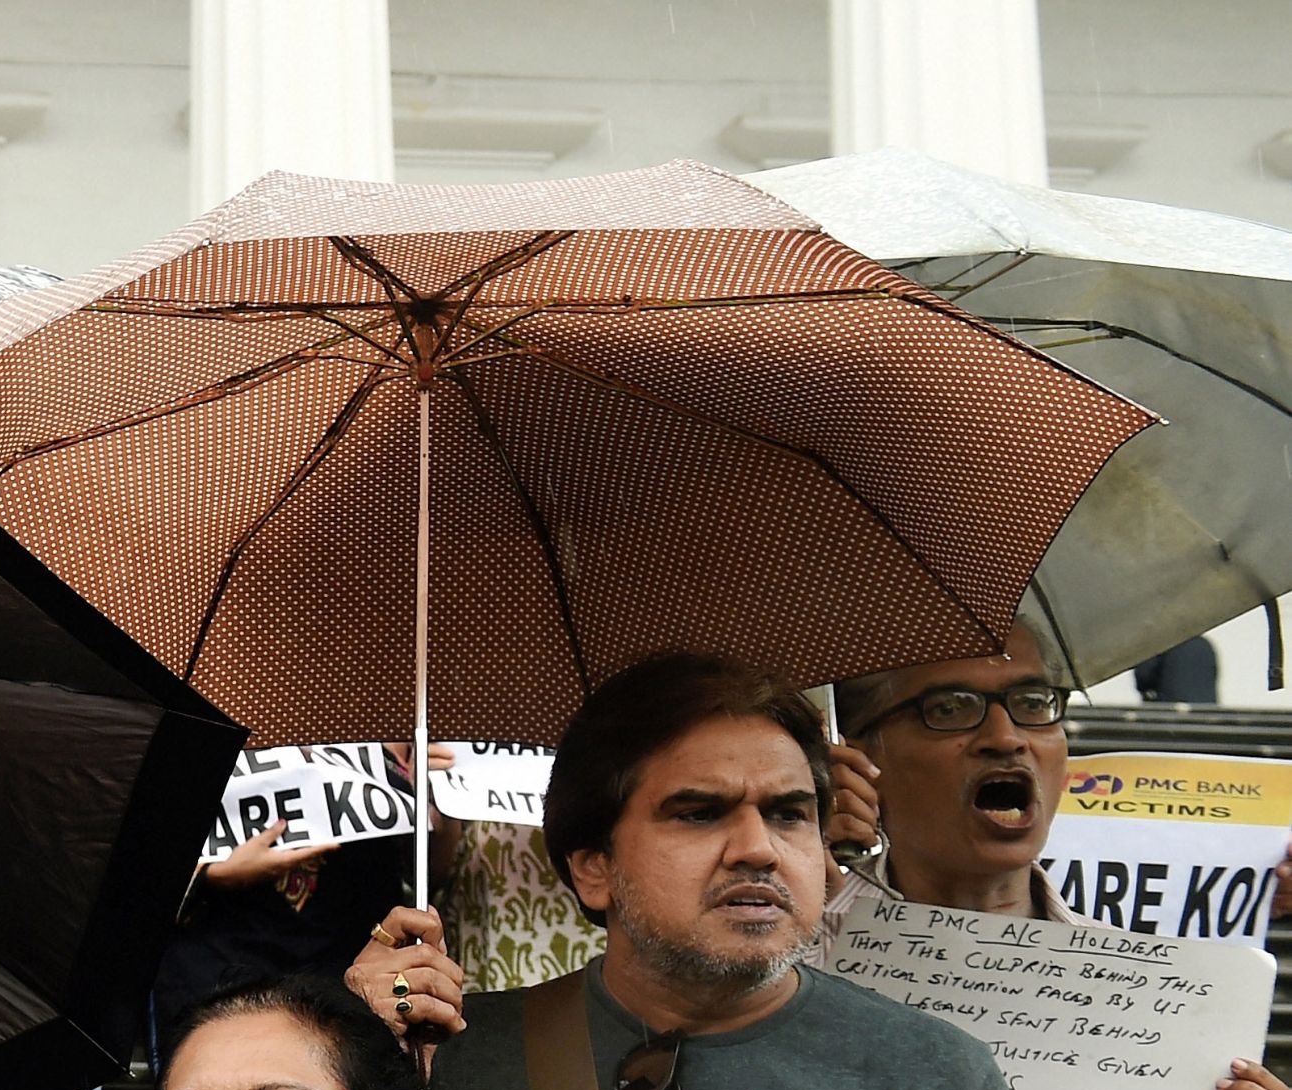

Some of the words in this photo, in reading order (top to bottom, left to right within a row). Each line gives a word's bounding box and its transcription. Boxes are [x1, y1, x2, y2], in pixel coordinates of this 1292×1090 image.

[1076, 798, 1232, 818] VICTIMS
[1135, 777, 1188, 792] PMC
[1197, 781, 1262, 796] BANK
[1039, 858, 1169, 936] ARE
[874, 900, 908, 922] WE
[928, 910, 979, 935] PMC
[1001, 923, 1042, 945] A/C
[1069, 930, 1178, 958] HOLDERS
[836, 958, 918, 983] CRITICAL
[927, 971, 1024, 995] SITUATION
[1035, 985, 1094, 1006] FACED
[1106, 994, 1135, 1011] BY
[1153, 999, 1186, 1016] US
[847, 930, 892, 952] THAT
[907, 940, 948, 961] THE
[965, 952, 1066, 978] CULPRITS
[1080, 963, 1148, 990] BEHIND
[1159, 976, 1212, 997] THIS
[904, 992, 989, 1022] LEGALLY
[997, 1010, 1058, 1033] SENT
[1068, 1017, 1162, 1046] BEHIND
[990, 1040, 1080, 1067] JUSTICE
[1097, 1057, 1173, 1079] GIVEN
